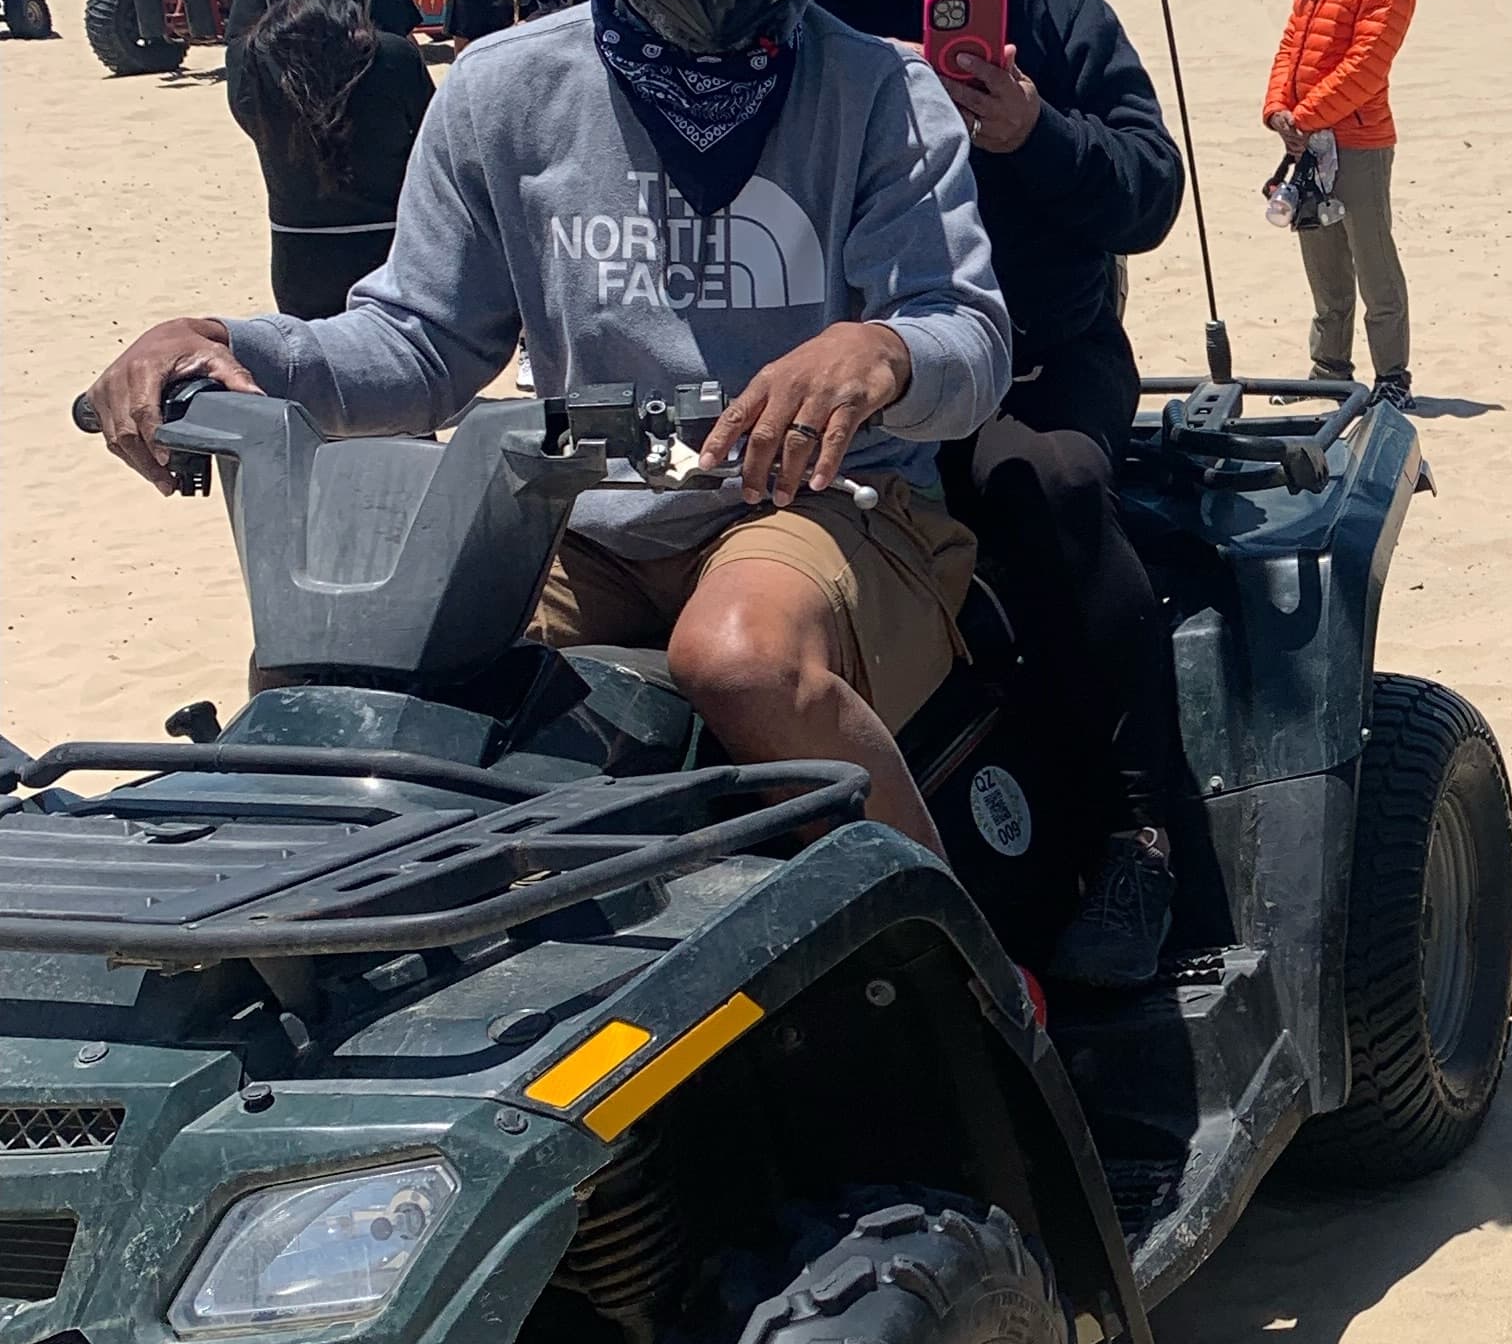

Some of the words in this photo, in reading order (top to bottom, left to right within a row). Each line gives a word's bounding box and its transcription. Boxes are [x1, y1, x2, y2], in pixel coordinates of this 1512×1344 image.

[627, 170, 726, 217] TH
[550, 213, 727, 263] NORTH
[598, 260, 728, 309] FACE
